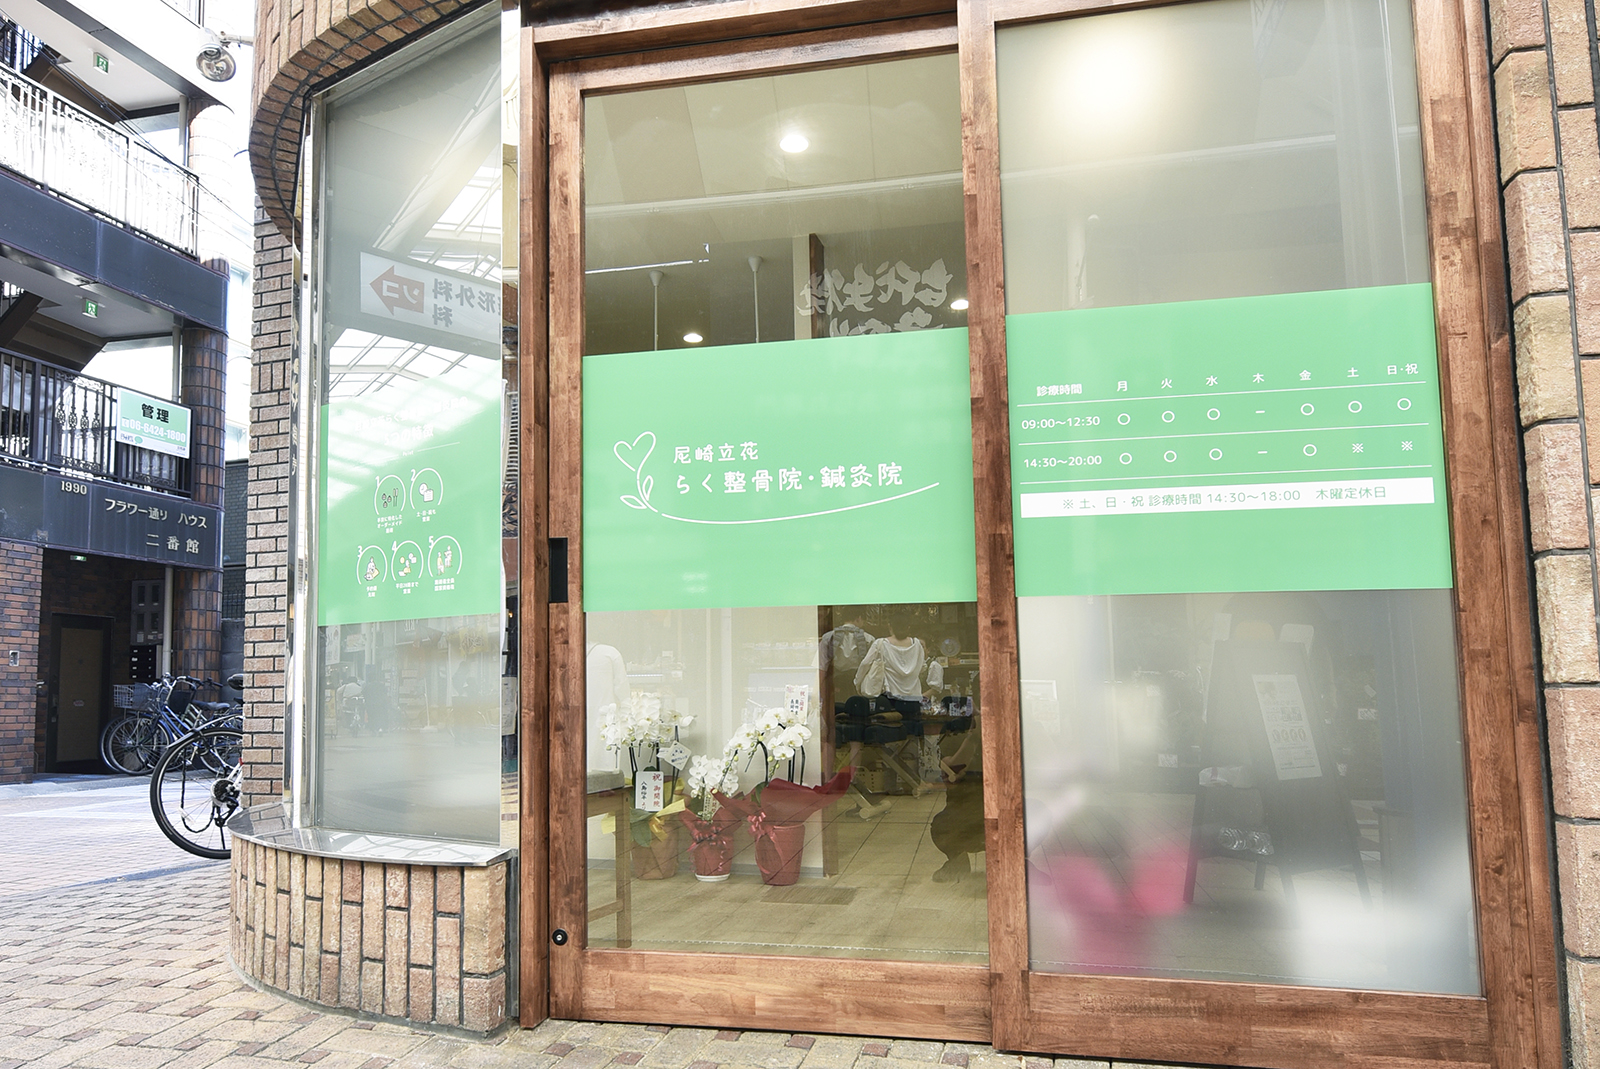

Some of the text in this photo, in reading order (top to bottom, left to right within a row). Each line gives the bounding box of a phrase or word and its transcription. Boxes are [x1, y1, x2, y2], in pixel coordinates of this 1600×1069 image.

[1036, 383, 1082, 397] 診療時間
[1116, 380, 1128, 392] 月
[1161, 378, 1172, 389] 火
[1205, 375, 1218, 386] 水
[1252, 372, 1264, 384] 木
[1299, 369, 1312, 381] 金
[1347, 367, 1359, 378] 土
[141, 403, 169, 424] 管理
[673, 441, 759, 465] 尼崎立花
[60, 480, 87, 495] 1990
[676, 461, 903, 495] らく整骨院・鍼灸院
[1148, 493, 1202, 507] 診療時間
[1315, 486, 1386, 501] 木曜定休日
[104, 498, 207, 529] フラワー通り ハウス
[146, 533, 199, 554] 二番館
